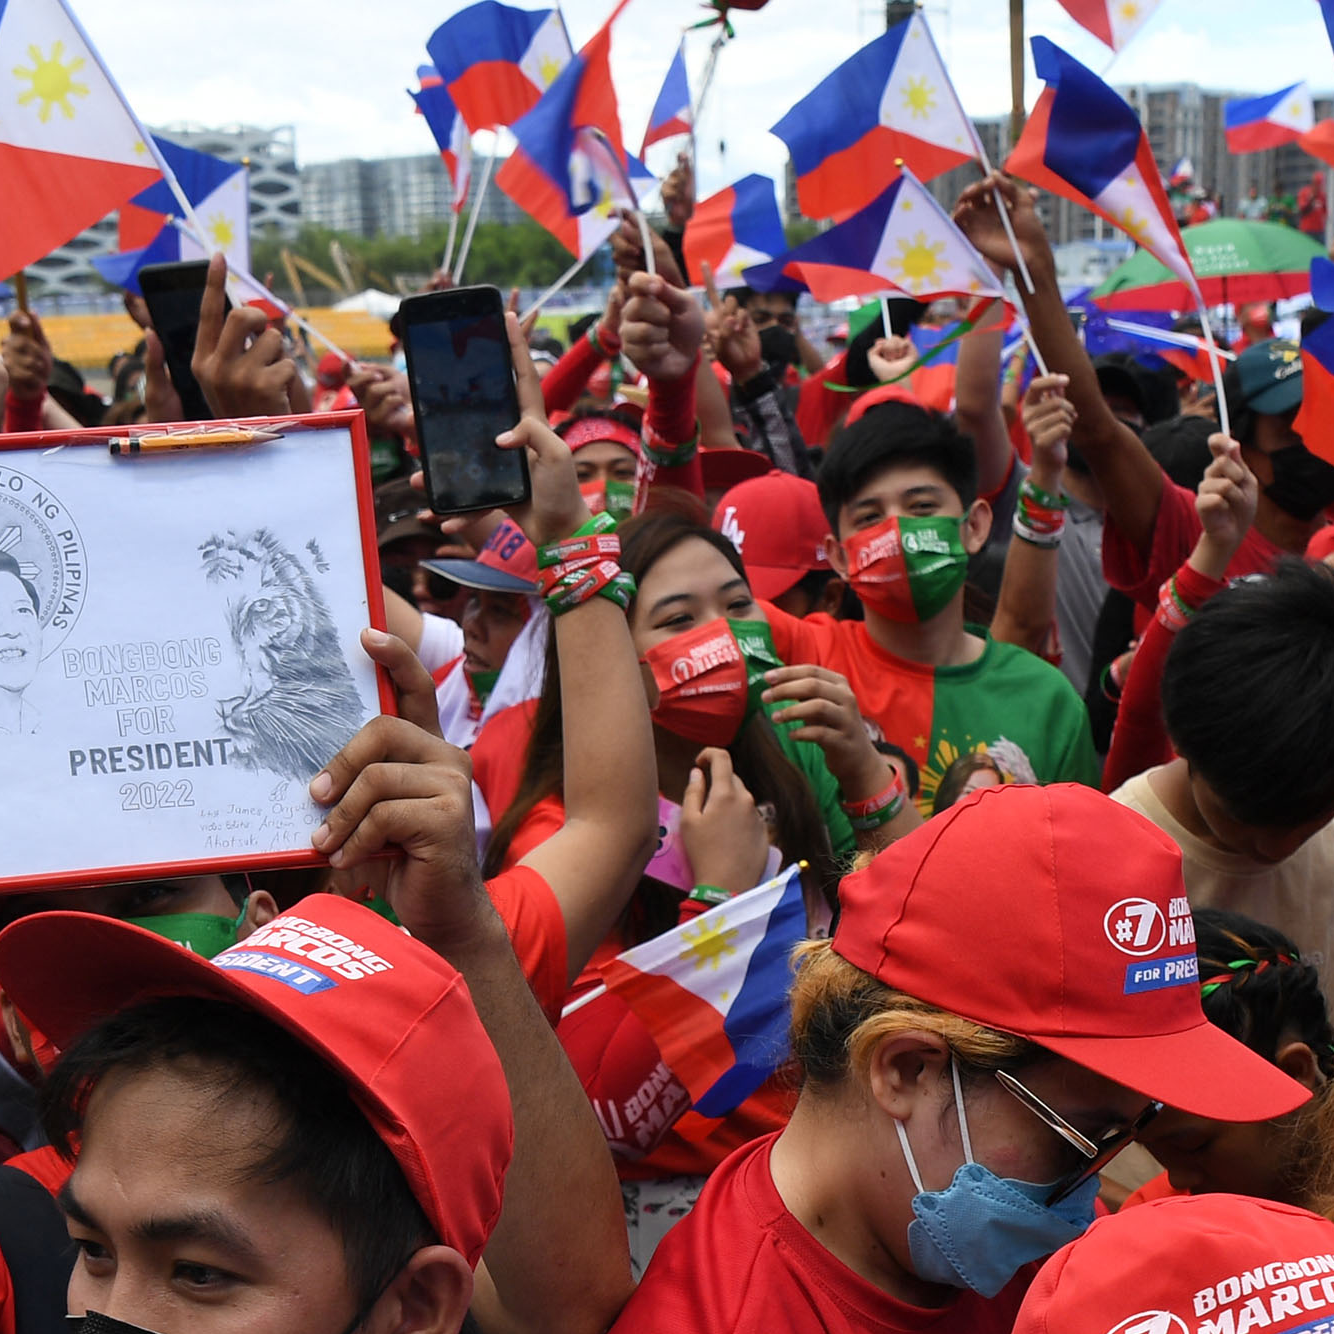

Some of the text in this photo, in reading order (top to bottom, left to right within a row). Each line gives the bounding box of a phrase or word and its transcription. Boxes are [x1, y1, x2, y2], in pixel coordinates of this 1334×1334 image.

[31, 491, 60, 521] NG
[52, 529, 82, 631] PILIPINAS
[62, 637, 222, 679] BONGBONG
[84, 671, 209, 707] MARCOS
[116, 704, 176, 737] FOR
[69, 738, 232, 776] PRESIDENT
[119, 779, 195, 811] 2022
[1134, 968, 1161, 984] FOR
